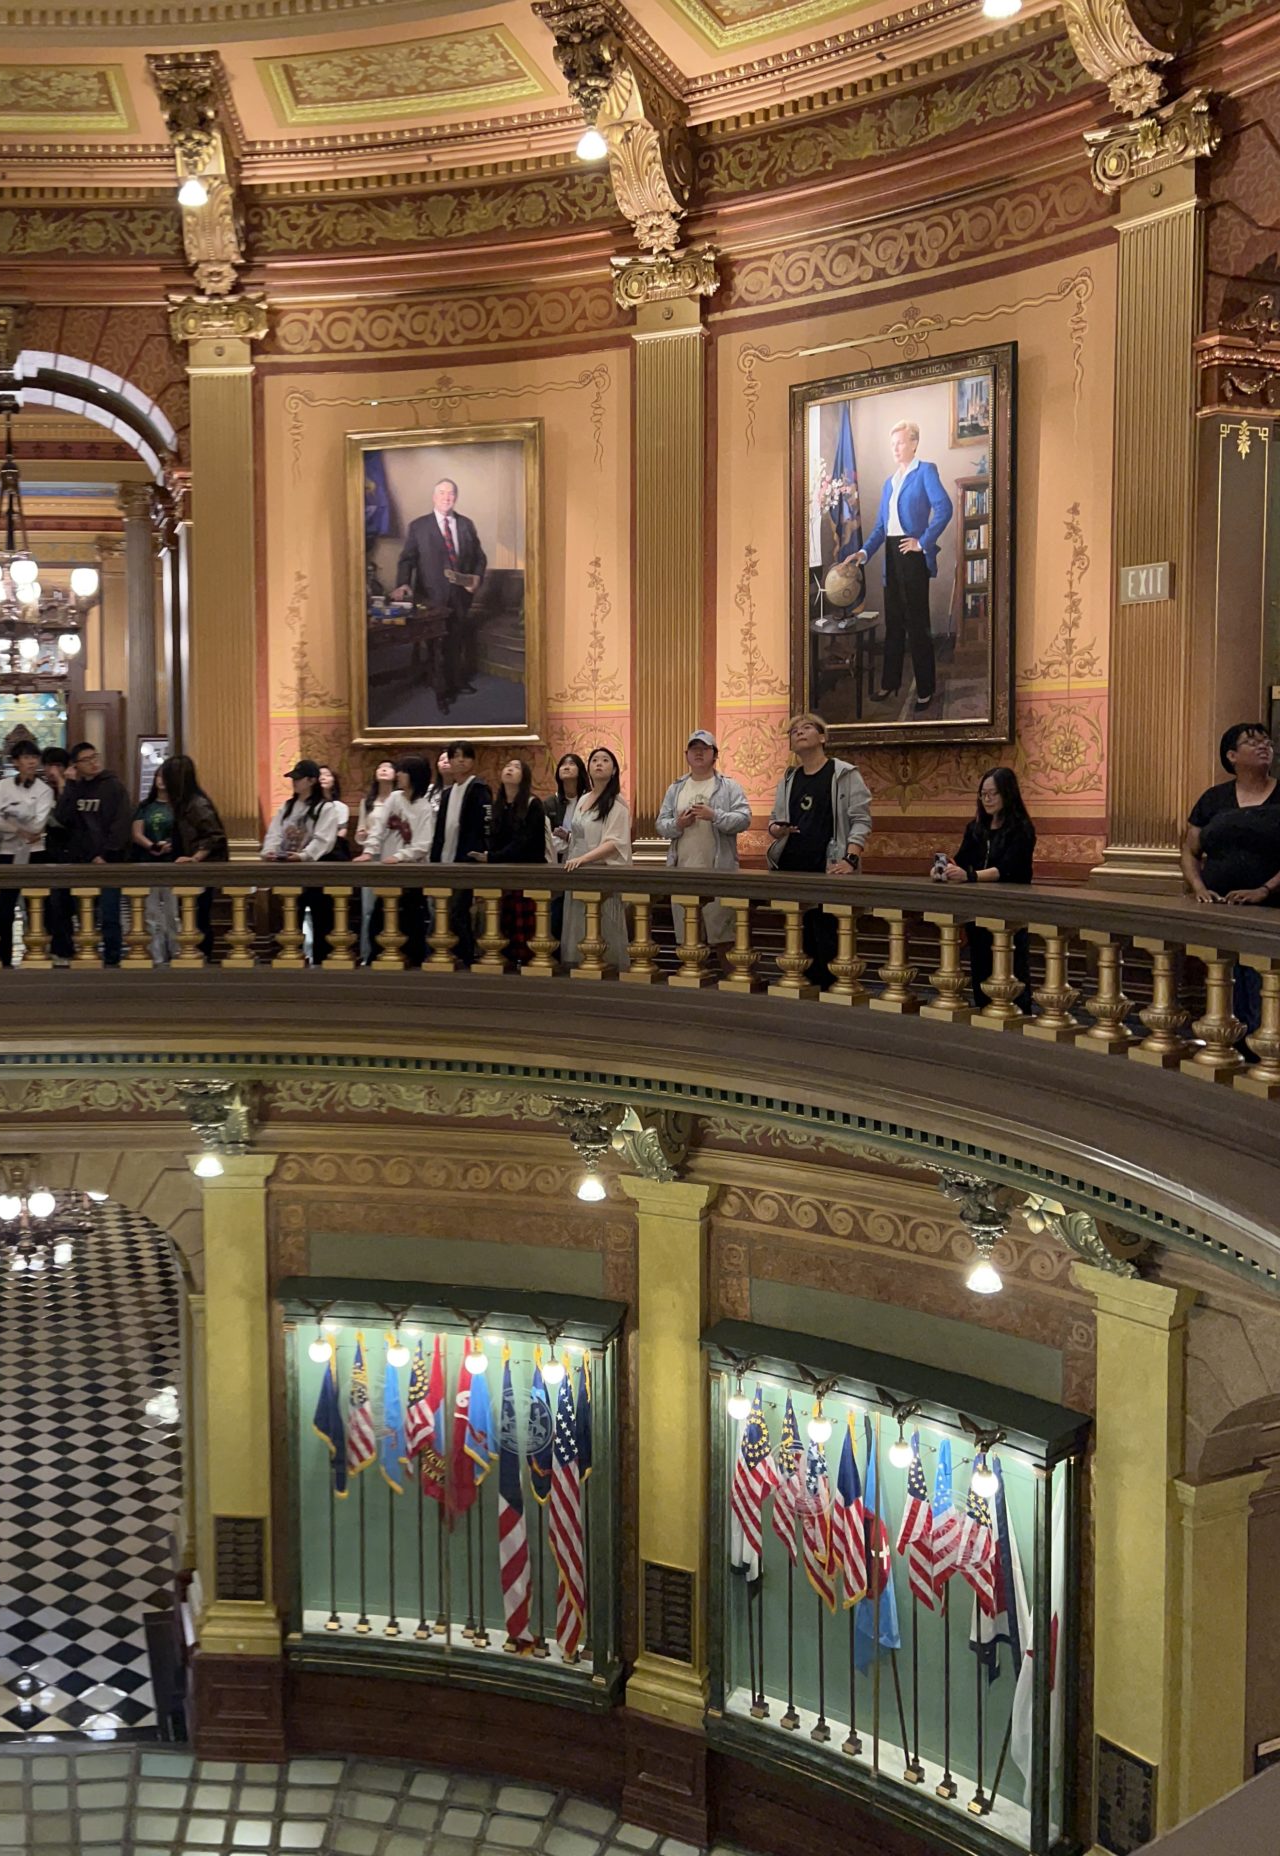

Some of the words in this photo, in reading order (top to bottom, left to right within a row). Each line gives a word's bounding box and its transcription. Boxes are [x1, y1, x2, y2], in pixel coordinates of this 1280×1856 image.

[842, 380, 857, 391] THE
[864, 376, 887, 387] STATE
[894, 373, 904, 381] OF
[910, 362, 953, 378] MICHIGAN
[1128, 567, 1163, 598] EXIT
